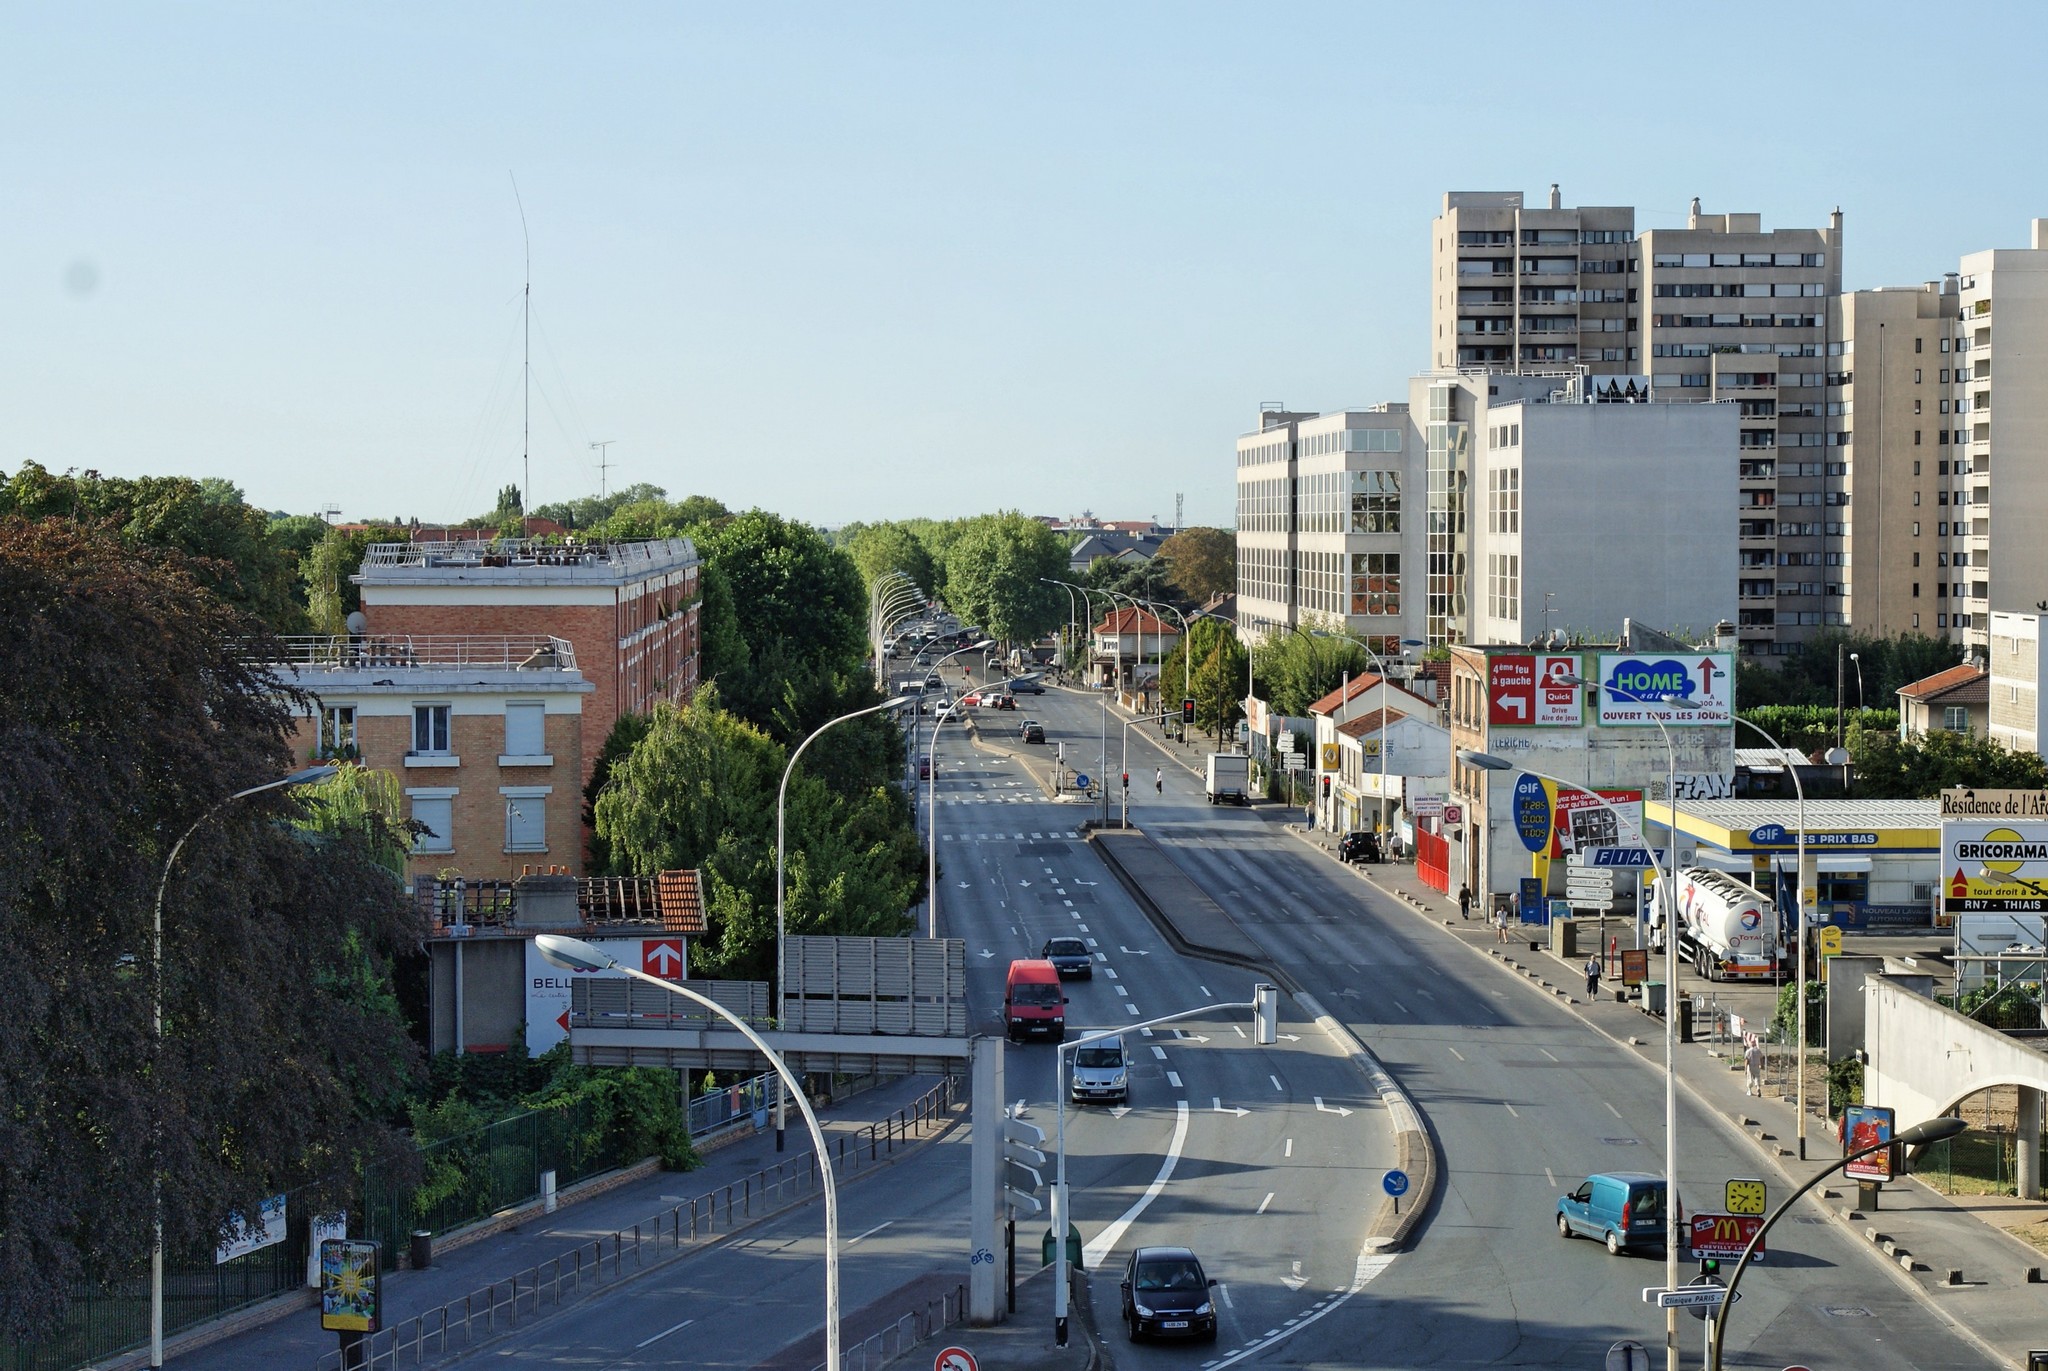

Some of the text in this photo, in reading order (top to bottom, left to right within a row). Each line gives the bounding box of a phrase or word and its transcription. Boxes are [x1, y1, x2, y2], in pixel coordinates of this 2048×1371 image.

[1515, 664, 1529, 674] feu
[1492, 676, 1532, 687] à gauche
[1618, 673, 1683, 690] HOME
[1547, 693, 1571, 701] Quick
[1564, 714, 1578, 722] jeux
[1603, 711, 1729, 720] OUVERT TOUS LES JOURS
[1518, 782, 1539, 793] elf
[1942, 793, 2001, 815] Résidence
[2005, 793, 2019, 815] de
[1756, 828, 1779, 840] elf
[1820, 834, 1848, 844] PRIX
[1851, 834, 1875, 844] BAS
[1959, 844, 2048, 859] BRICORAMA
[1974, 888, 1992, 896] tout
[1996, 888, 2018, 896] droit
[2021, 887, 2027, 896] à
[1964, 900, 1988, 909] RN7
[2003, 901, 2041, 910] THIAIS
[1664, 1297, 1692, 1305] Clinique
[1694, 1294, 1715, 1303] PARIS
